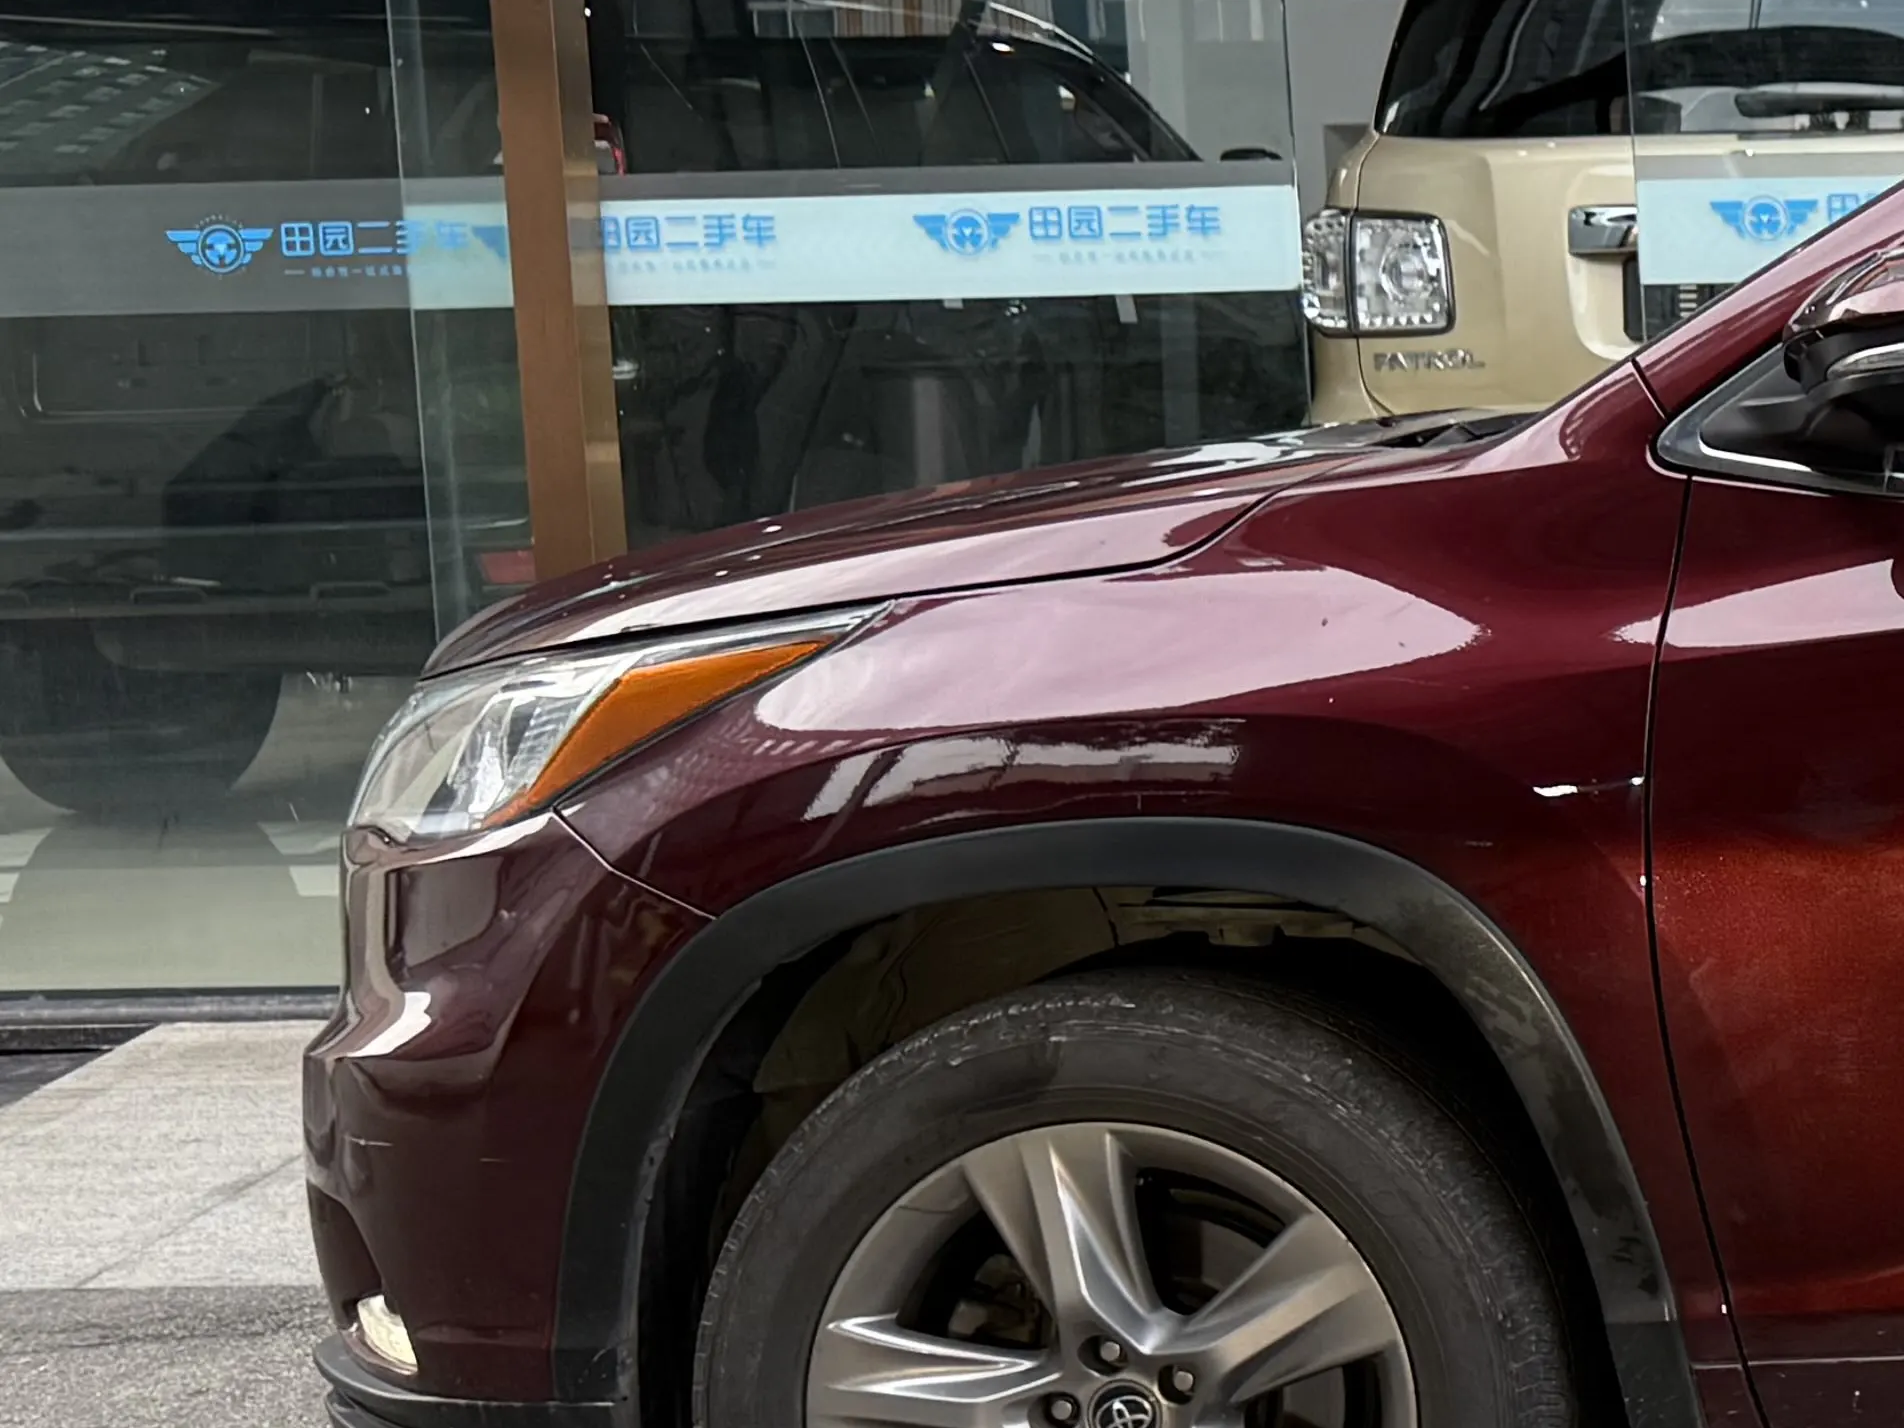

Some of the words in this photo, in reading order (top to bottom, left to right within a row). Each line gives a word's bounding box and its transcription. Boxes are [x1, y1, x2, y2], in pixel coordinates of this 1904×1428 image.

[1028, 204, 1221, 240] 田园二手车
